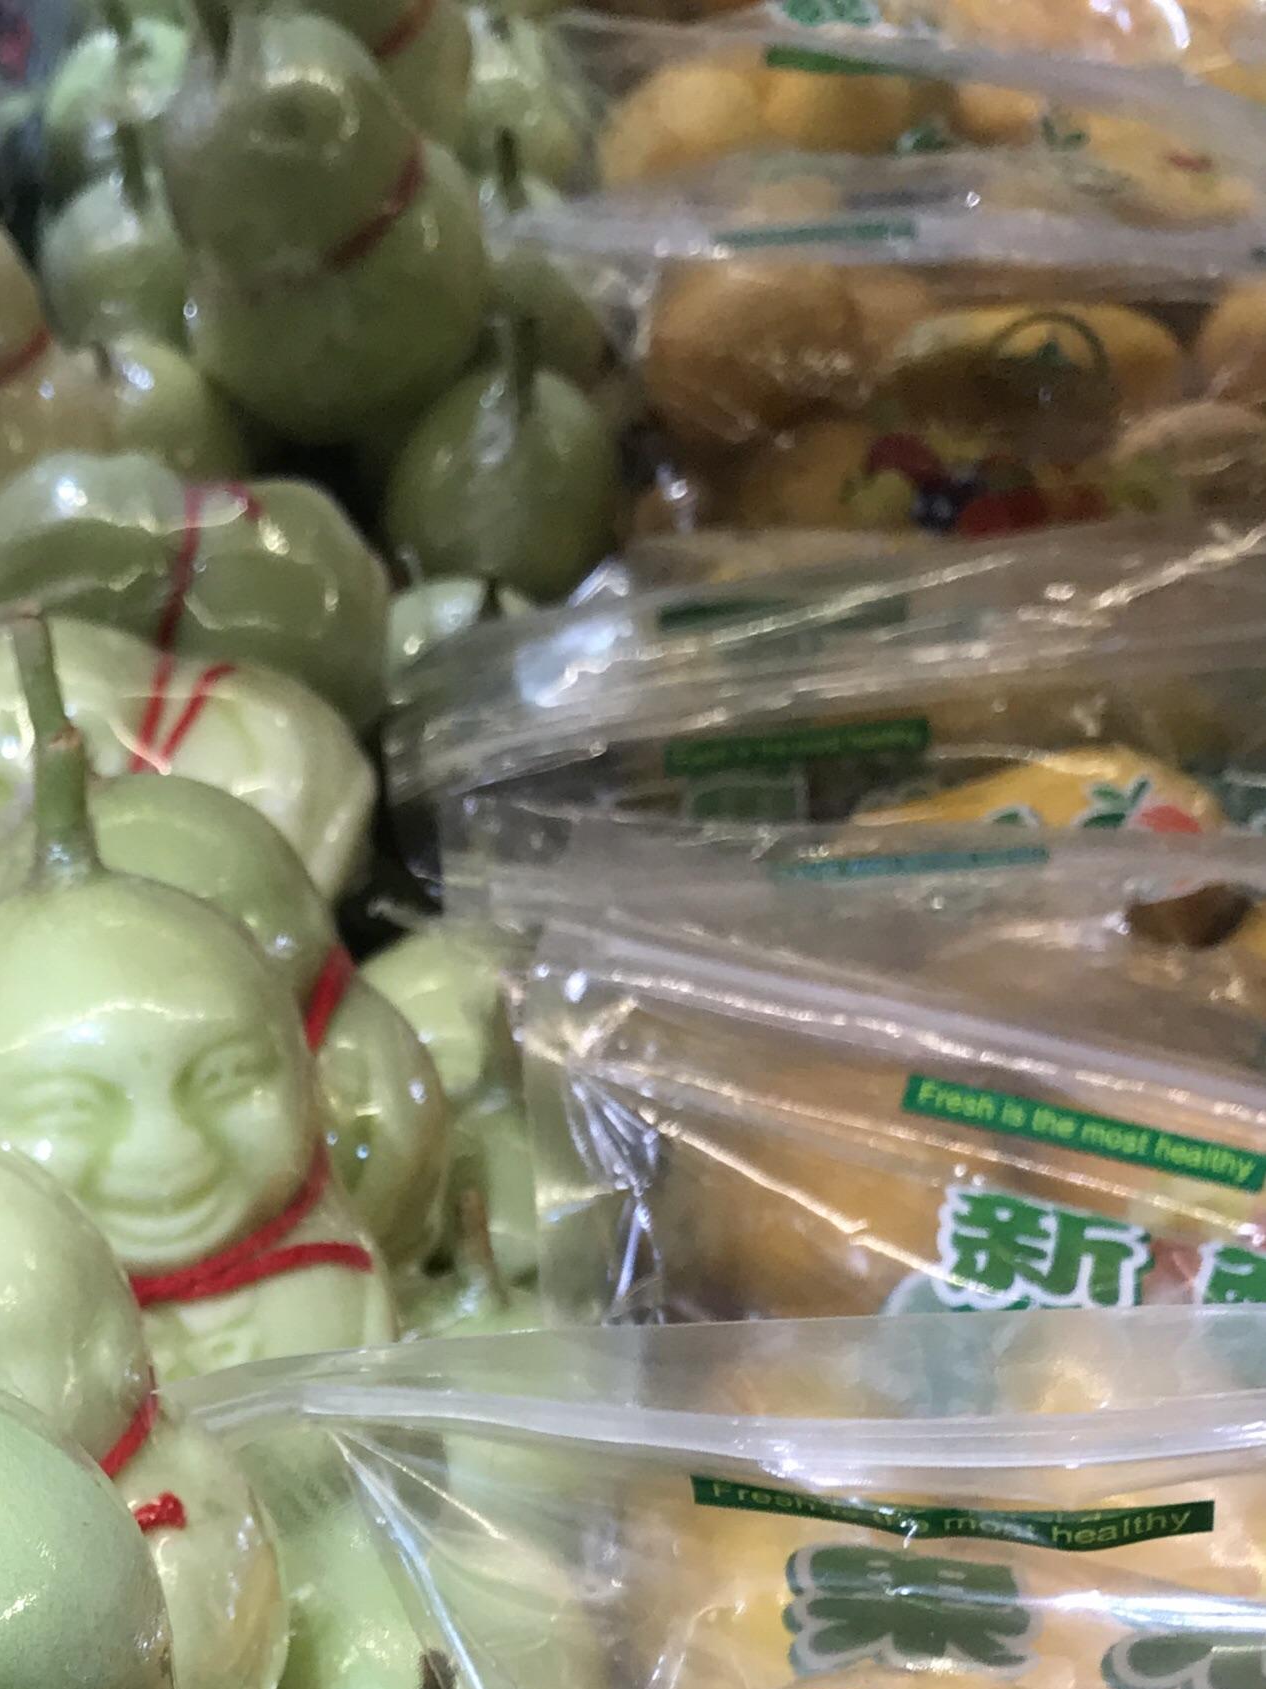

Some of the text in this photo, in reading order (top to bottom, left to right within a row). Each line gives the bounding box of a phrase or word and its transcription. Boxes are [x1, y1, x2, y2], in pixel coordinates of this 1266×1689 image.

[918, 1080, 1257, 1183] Fresh is the most healthy
[1051, 1508, 1192, 1546] healthy
